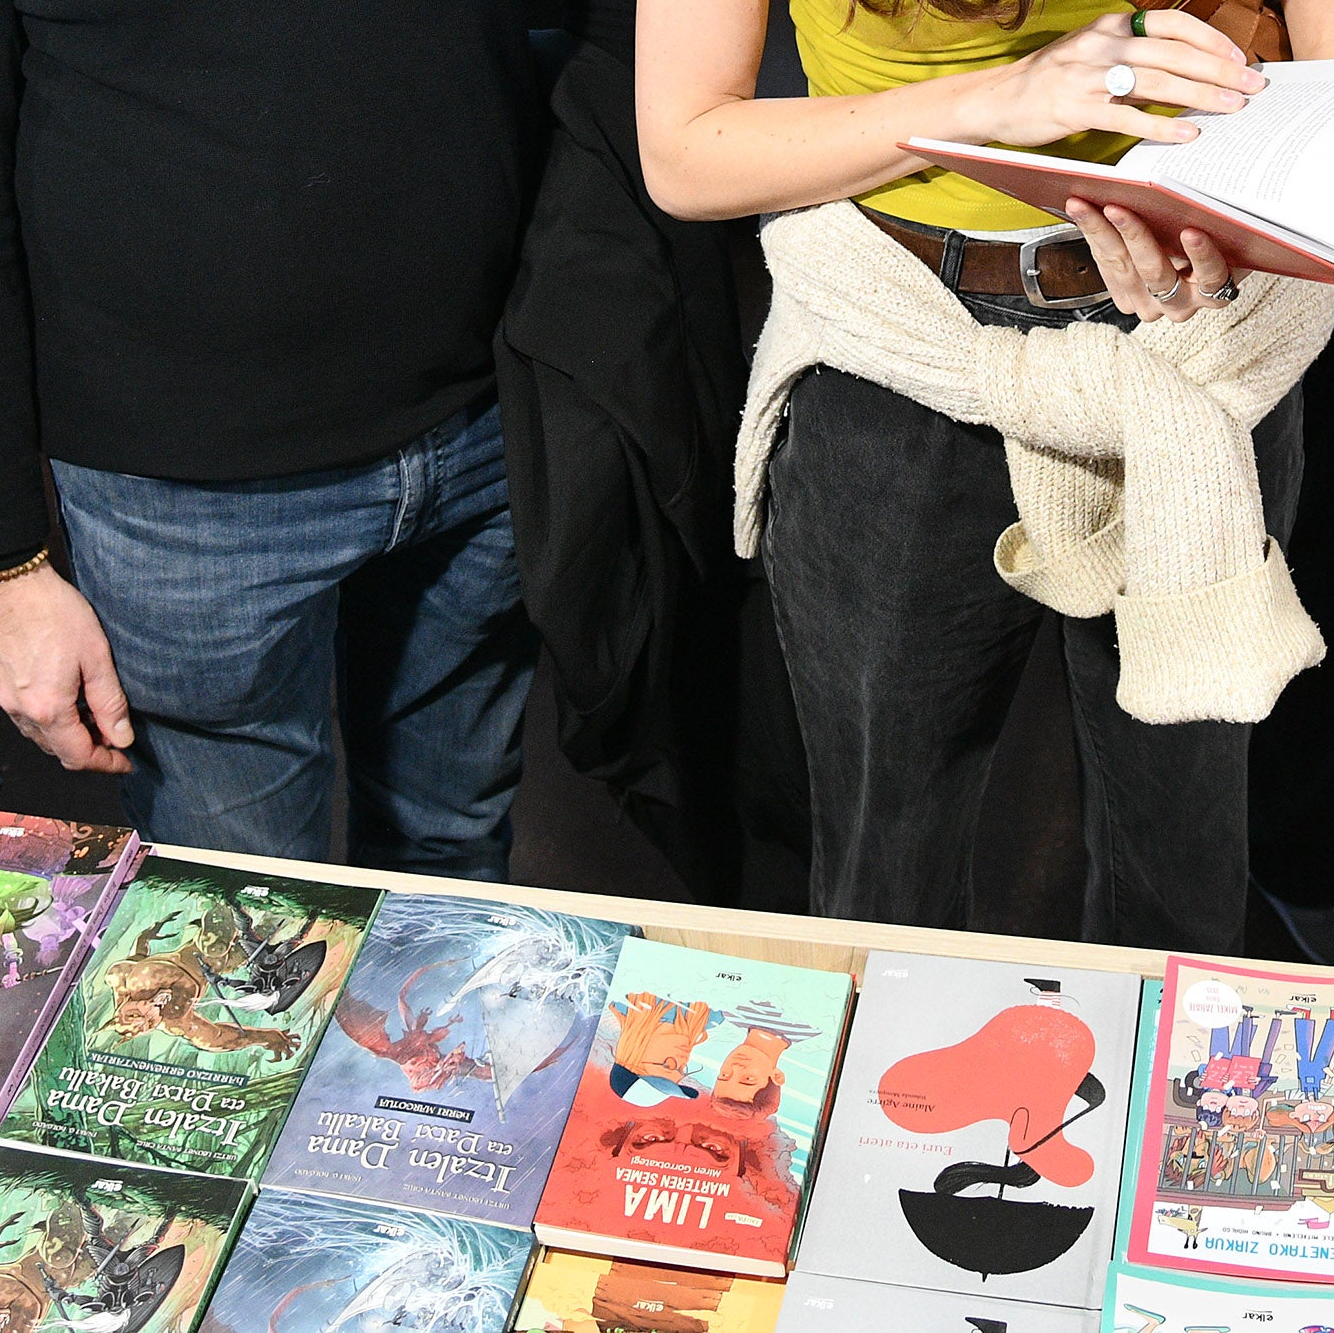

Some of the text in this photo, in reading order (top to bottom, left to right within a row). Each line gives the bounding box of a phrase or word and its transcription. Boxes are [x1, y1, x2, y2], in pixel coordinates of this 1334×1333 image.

[241, 885, 269, 897] elkar
[488, 915, 517, 927] elkar
[715, 972, 742, 983] elkar
[881, 969, 909, 980] elkar
[1289, 994, 1317, 1004] elkar
[1215, 1004, 1239, 1014] MIKEL
[58, 1066, 245, 1112] eta Patxi Bakallu
[867, 1098, 936, 1113] Alaine Agirre
[46, 1088, 246, 1147] Itzalen Dama
[316, 1110, 513, 1156] eta Patxi Bakallu
[859, 1137, 953, 1156] Euri eta ateri
[306, 1134, 517, 1194] Itzalen Dama
[630, 1154, 722, 1179] Miren Gorrotxategi
[91, 1179, 124, 1193] elkar
[615, 1167, 731, 1197] MARTEREN SEMEA
[624, 1185, 714, 1229] LIMA
[373, 1224, 406, 1238] elkar
[1222, 1226, 1249, 1235] HIDALGO
[1204, 1237, 1260, 1255] ZIRKUA
[632, 1298, 665, 1313] elkar
[804, 1298, 835, 1310] elkar
[1243, 1311, 1274, 1323] elkar
